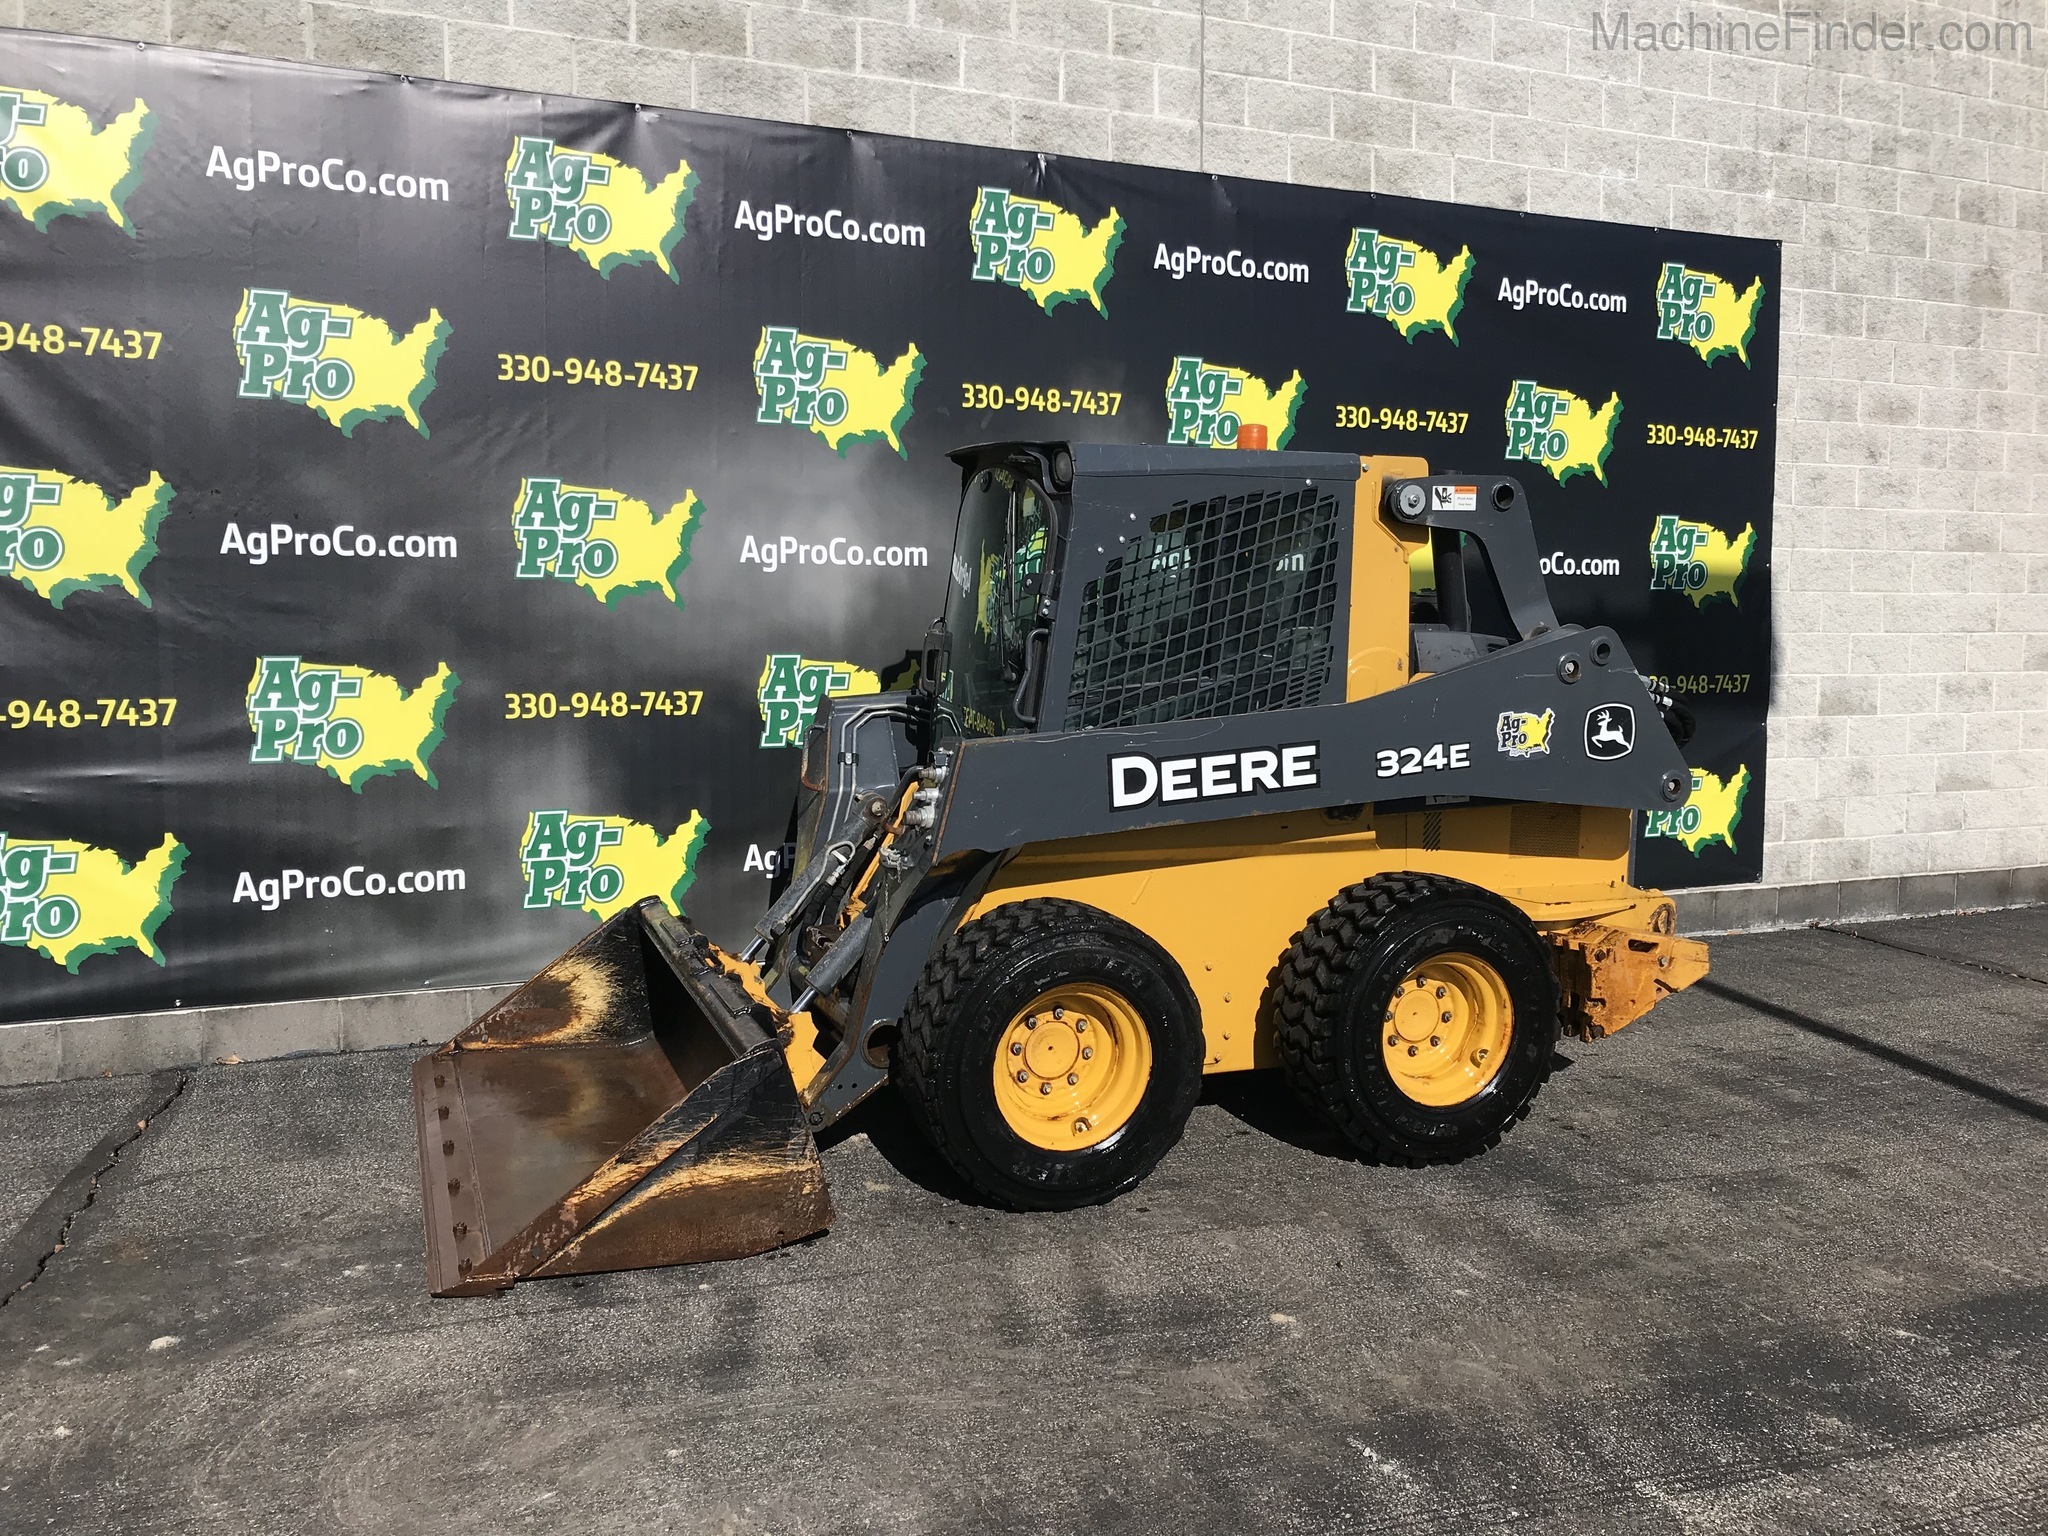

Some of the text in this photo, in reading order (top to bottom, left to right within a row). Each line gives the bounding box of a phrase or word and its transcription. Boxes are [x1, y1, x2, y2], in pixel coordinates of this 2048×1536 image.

[206, 145, 449, 201] AgProCo.com
[507, 137, 610, 202] Ag-
[507, 190, 610, 243] Pro
[735, 201, 926, 246] AgProCo.com
[973, 188, 1053, 245] Ag-
[973, 235, 1053, 282] Pro
[1154, 243, 1309, 282] AgProCo.com
[1348, 229, 1414, 281] Ag-
[1348, 272, 1414, 314] Pro
[1498, 277, 1627, 312] AgProCo.com
[1658, 263, 1714, 310] Ag-
[0, 321, 162, 360] 948-7437
[238, 289, 353, 356] Ag-
[1658, 302, 1714, 340] Pro
[238, 344, 353, 399] Pro
[498, 354, 699, 391] 330-948-7437
[757, 327, 847, 386] Ag-
[757, 376, 847, 424] Pro
[962, 384, 1121, 416] 330-948-7437
[1169, 358, 1241, 410] Ag-
[1507, 381, 1568, 429] Ag-
[1169, 401, 1241, 444] Pro
[1336, 406, 1468, 434] 330-948-7437
[1507, 420, 1568, 459] Pro
[1647, 424, 1758, 449] 330-948-7437
[516, 478, 616, 538] Ag-
[0, 526, 63, 570] ro
[220, 523, 457, 565] AgProCo.com
[516, 528, 616, 577] Pro
[740, 535, 928, 572] AgProCo.com
[1651, 516, 1707, 560] Ag-
[1540, 551, 1620, 575] oCo.com
[1651, 553, 1707, 589] Pro
[250, 658, 362, 721] Ag-
[505, 690, 703, 719] 330-948-7437
[250, 710, 362, 761] Pro
[1501, 731, 1527, 748] Pro
[1111, 745, 1317, 808] DEERE
[1376, 743, 1470, 777] 324E
[523, 810, 622, 870] Ag-
[233, 866, 466, 910] AgProCo.com
[523, 859, 622, 908] Pro
